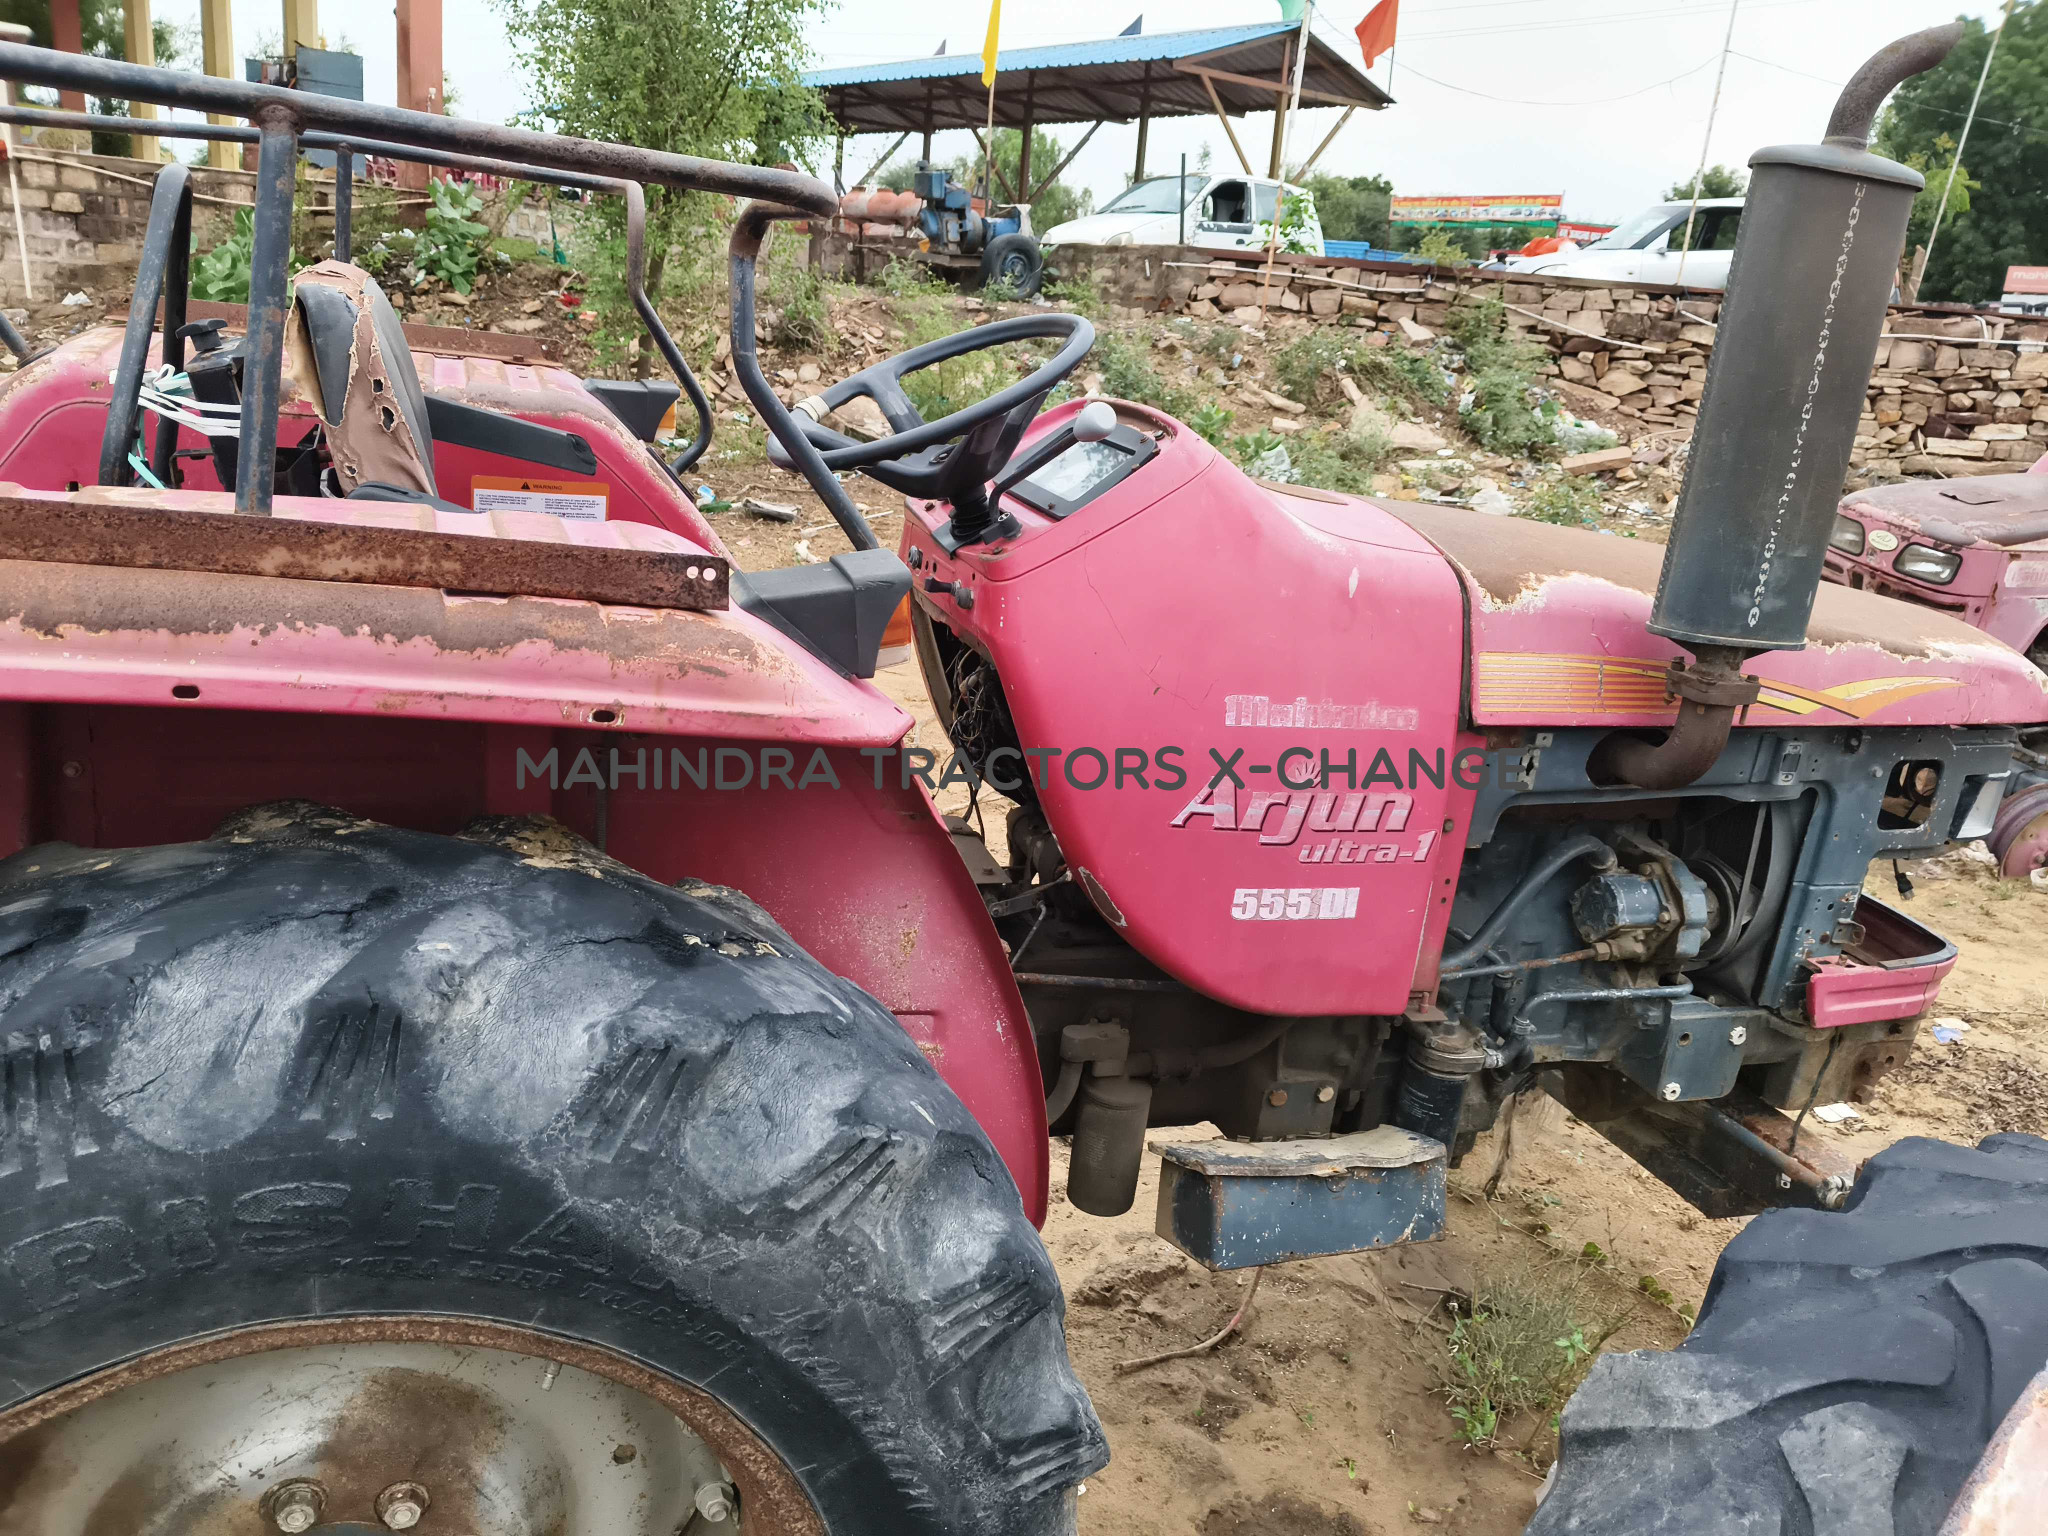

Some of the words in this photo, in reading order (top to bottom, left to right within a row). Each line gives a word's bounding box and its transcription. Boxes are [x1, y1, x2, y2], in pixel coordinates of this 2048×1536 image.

[1170, 772, 1414, 846] Arjun
[1299, 829, 1438, 865] ultra-1
[1231, 888, 1318, 921] 555
[1319, 887, 1361, 920] DI
